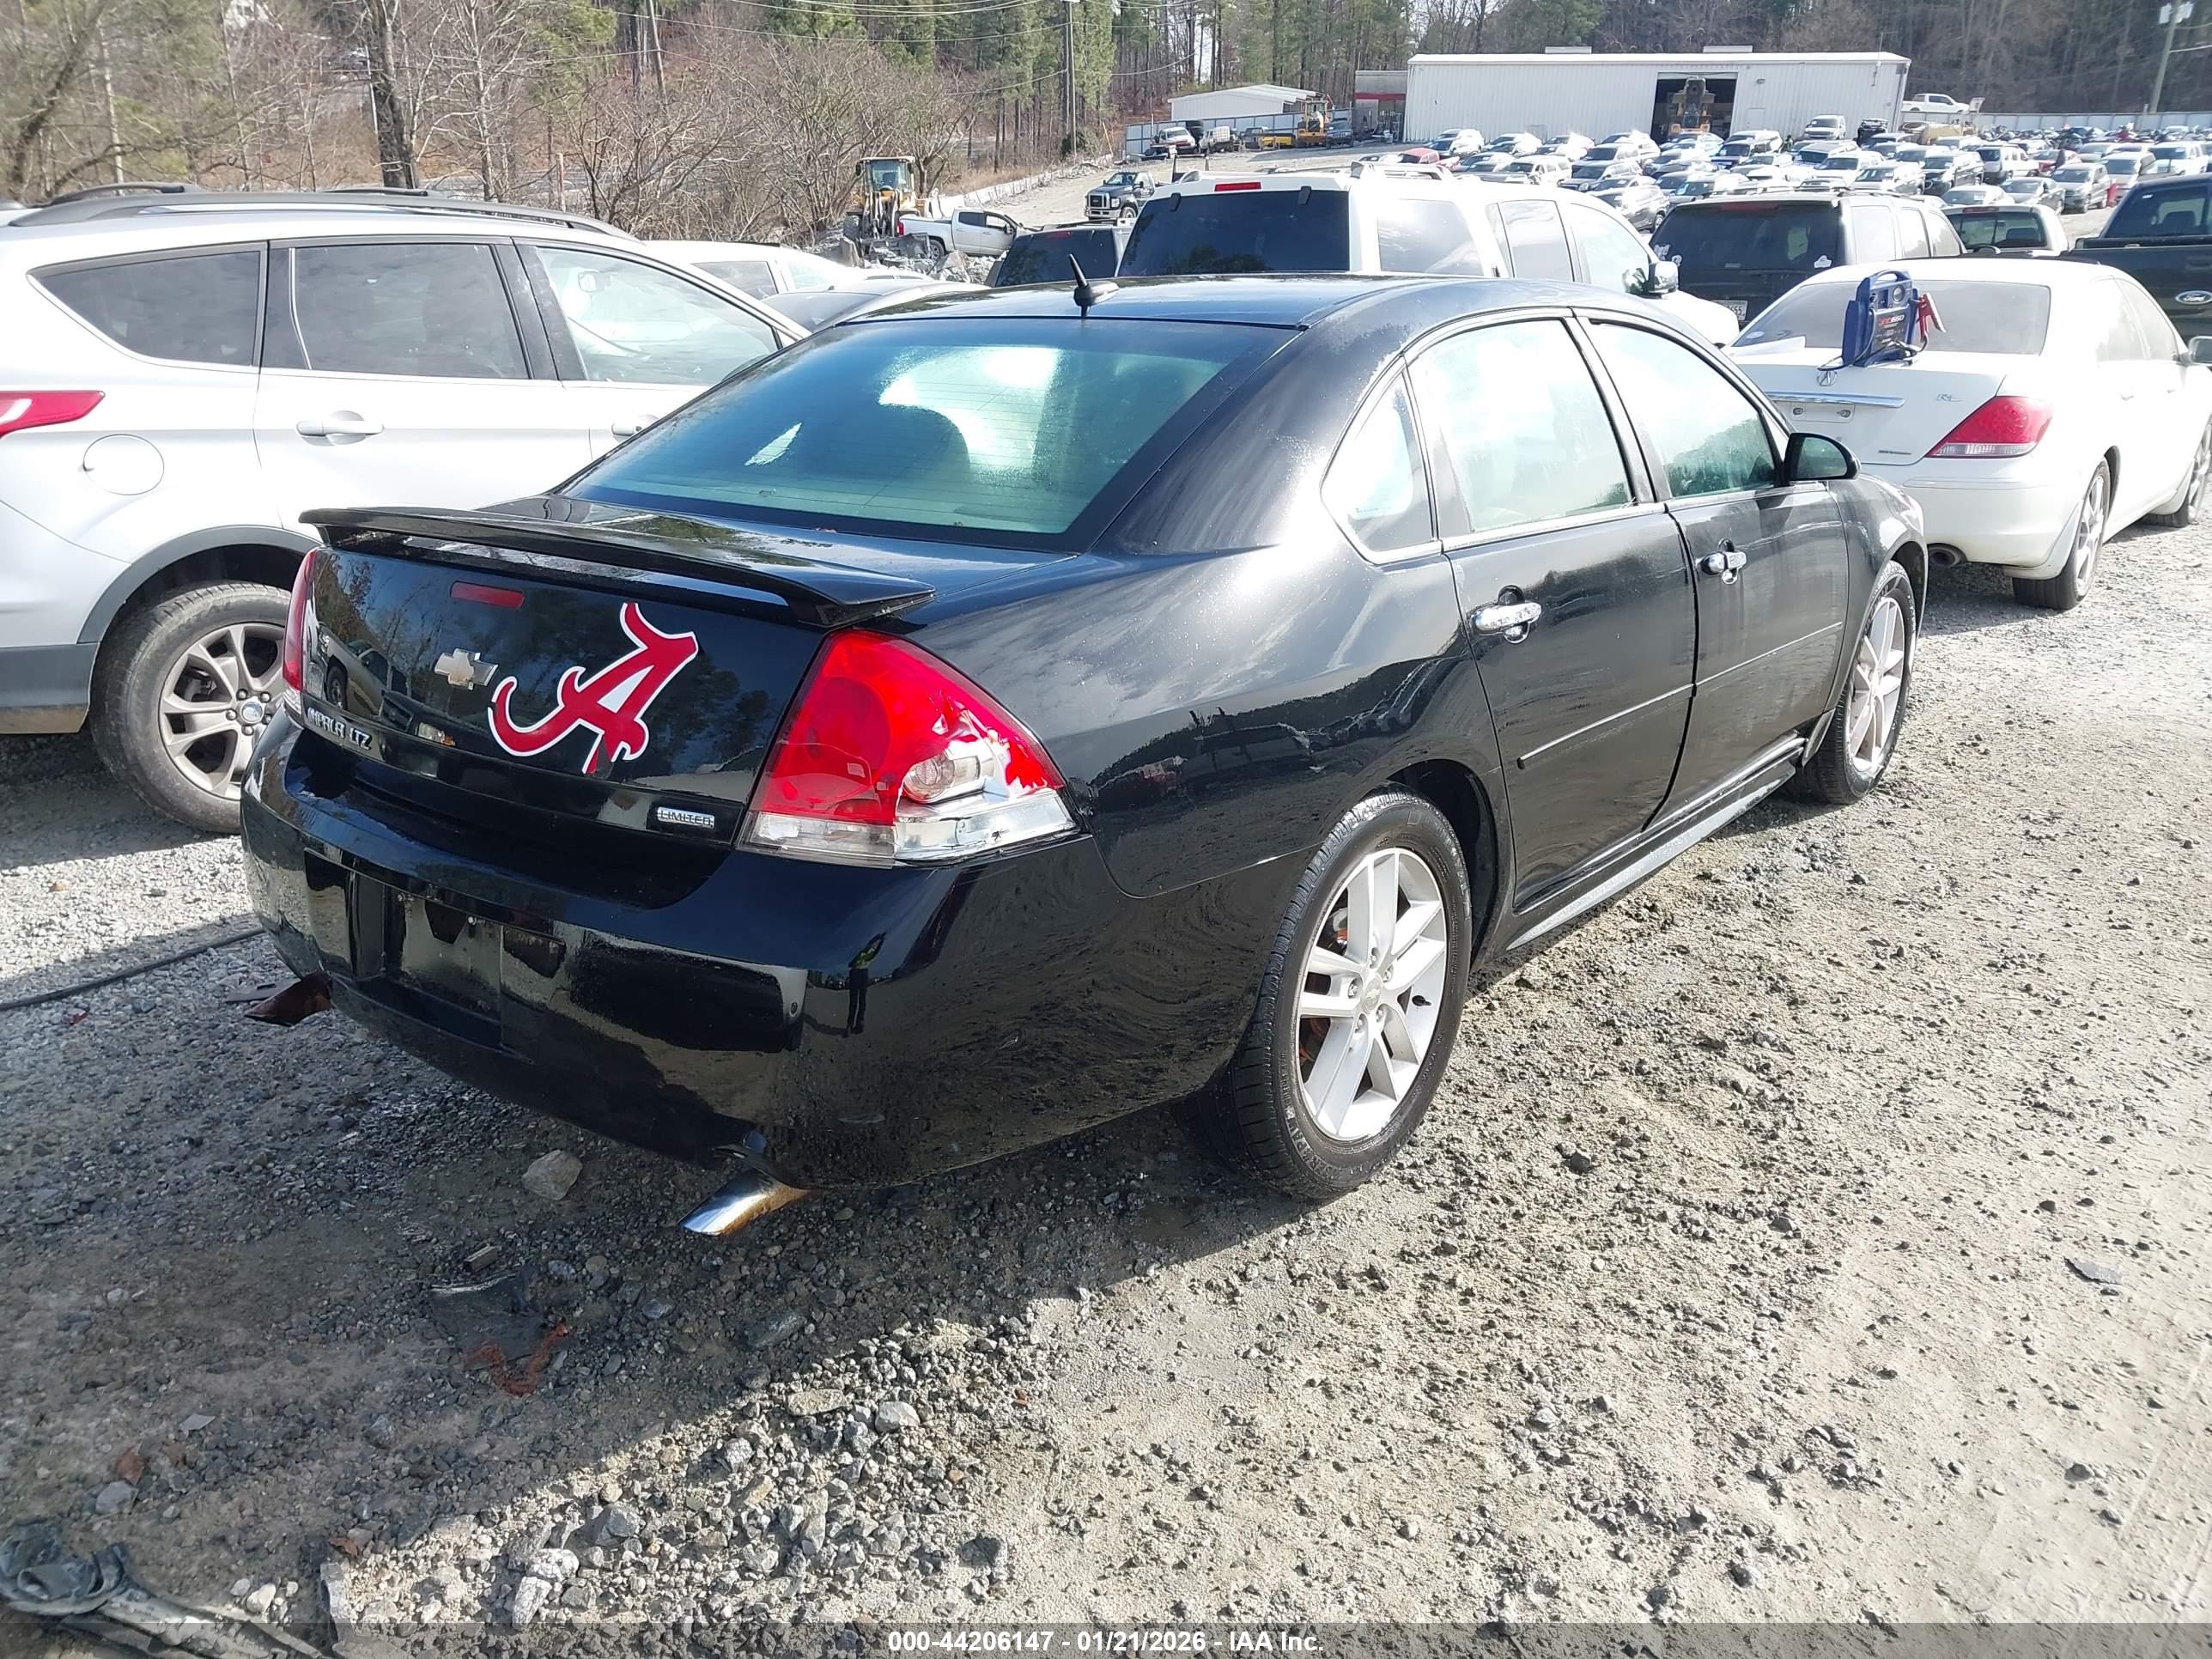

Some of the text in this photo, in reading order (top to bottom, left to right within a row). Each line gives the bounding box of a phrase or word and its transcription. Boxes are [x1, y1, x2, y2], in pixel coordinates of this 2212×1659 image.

[307, 707, 372, 750] IMPALA LTZ
[659, 810, 712, 827] LIMITED
